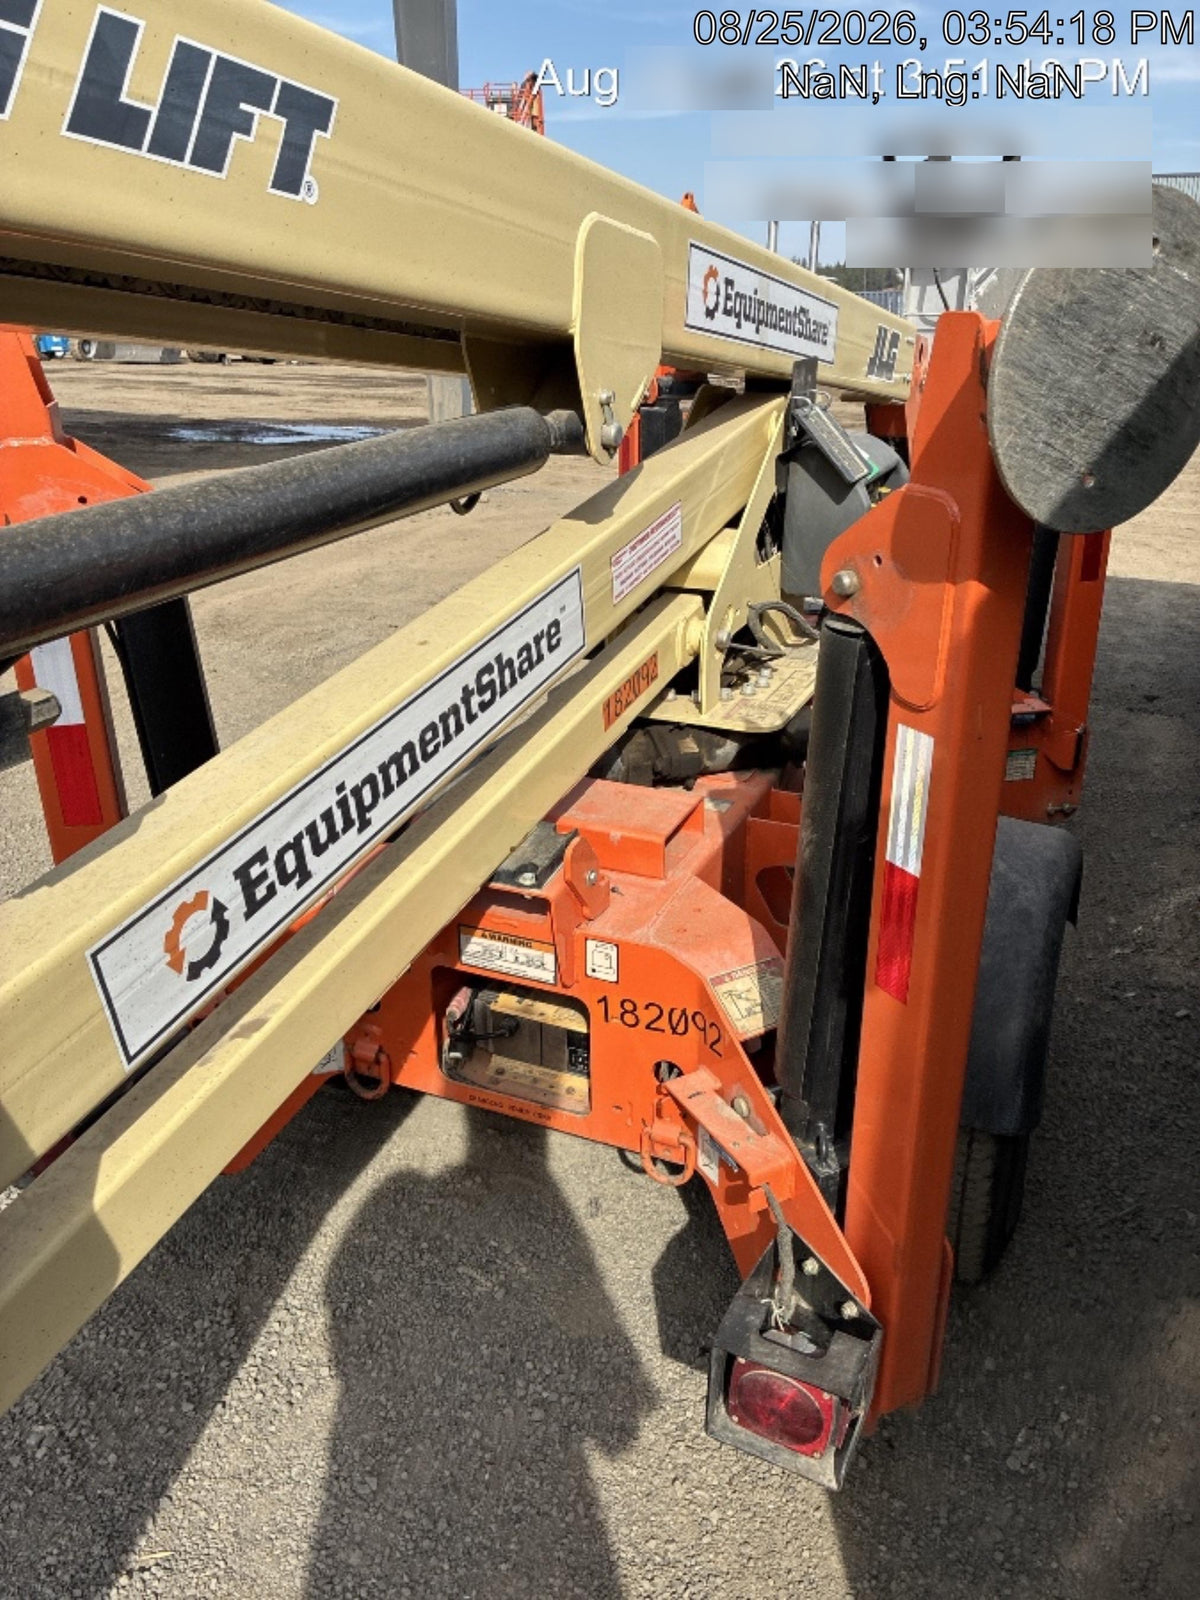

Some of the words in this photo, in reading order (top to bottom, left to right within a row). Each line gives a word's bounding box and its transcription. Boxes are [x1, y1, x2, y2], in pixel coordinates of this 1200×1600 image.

[62, 6, 338, 199] LIFT
[722, 276, 829, 346] EquipmentShare
[602, 653, 659, 727] 182092
[232, 615, 563, 922] EquipmentShare
[596, 994, 724, 1058] 182092
